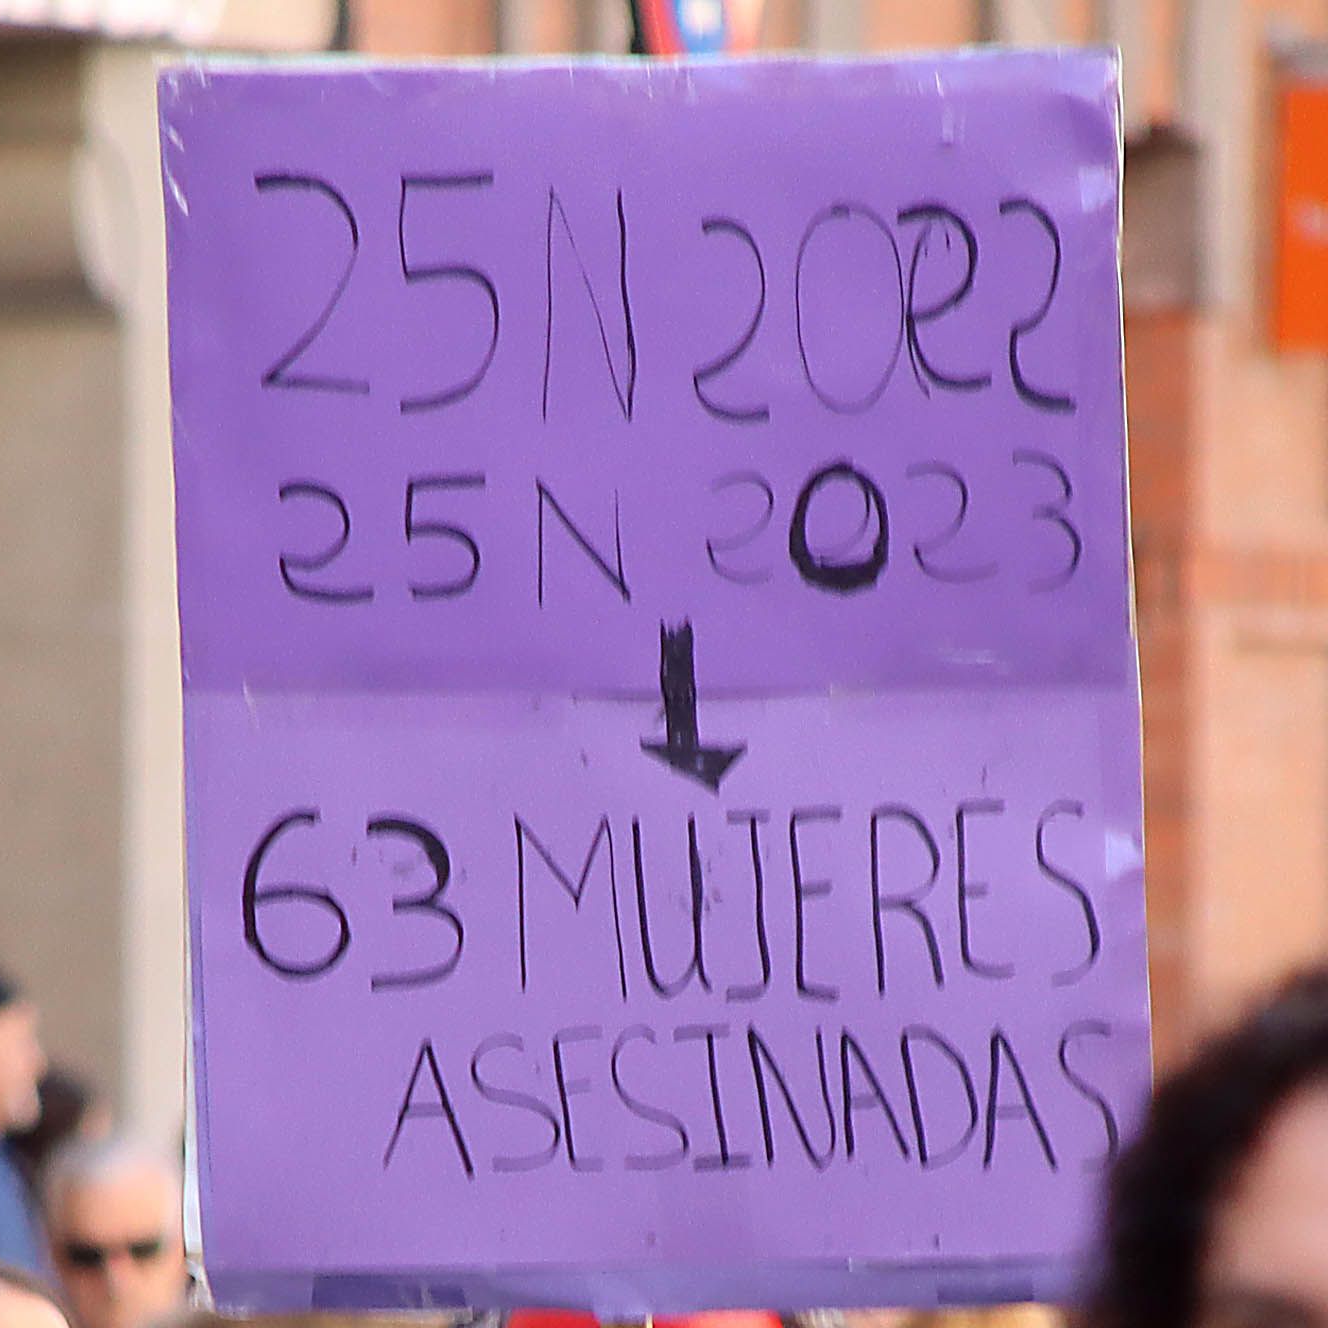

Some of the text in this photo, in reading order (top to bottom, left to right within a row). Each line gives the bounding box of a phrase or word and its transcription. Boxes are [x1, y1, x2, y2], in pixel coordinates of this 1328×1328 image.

[705, 450, 1083, 599] 2023
[240, 797, 1102, 1006] 63 MUJERES
[382, 1018, 1120, 1178] ASESINADAS
